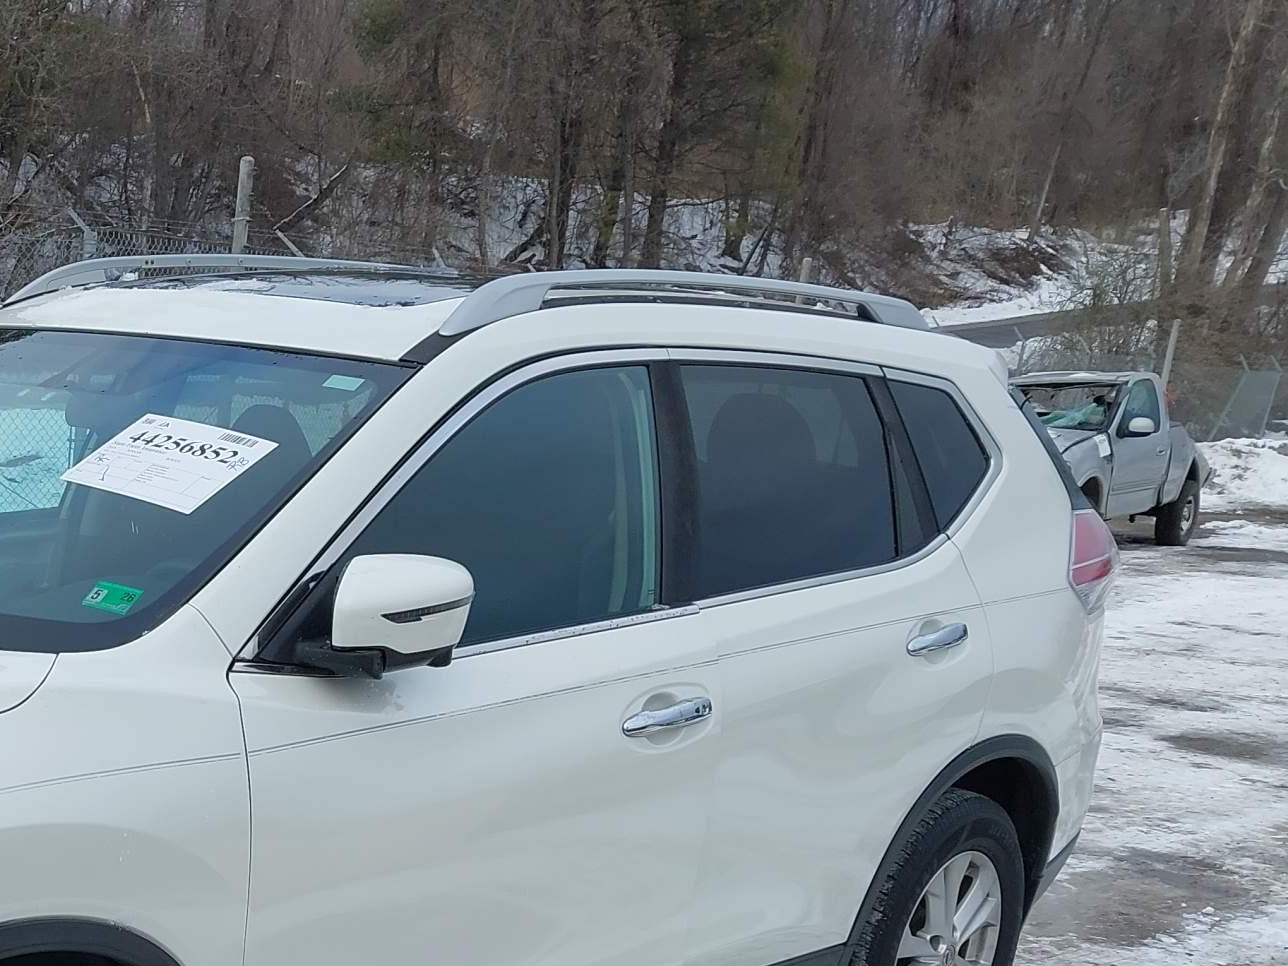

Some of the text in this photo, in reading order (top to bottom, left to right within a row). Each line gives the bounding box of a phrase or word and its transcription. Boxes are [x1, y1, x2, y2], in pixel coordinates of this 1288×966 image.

[129, 431, 239, 464] 44256852
[90, 589, 137, 603] 5 26
